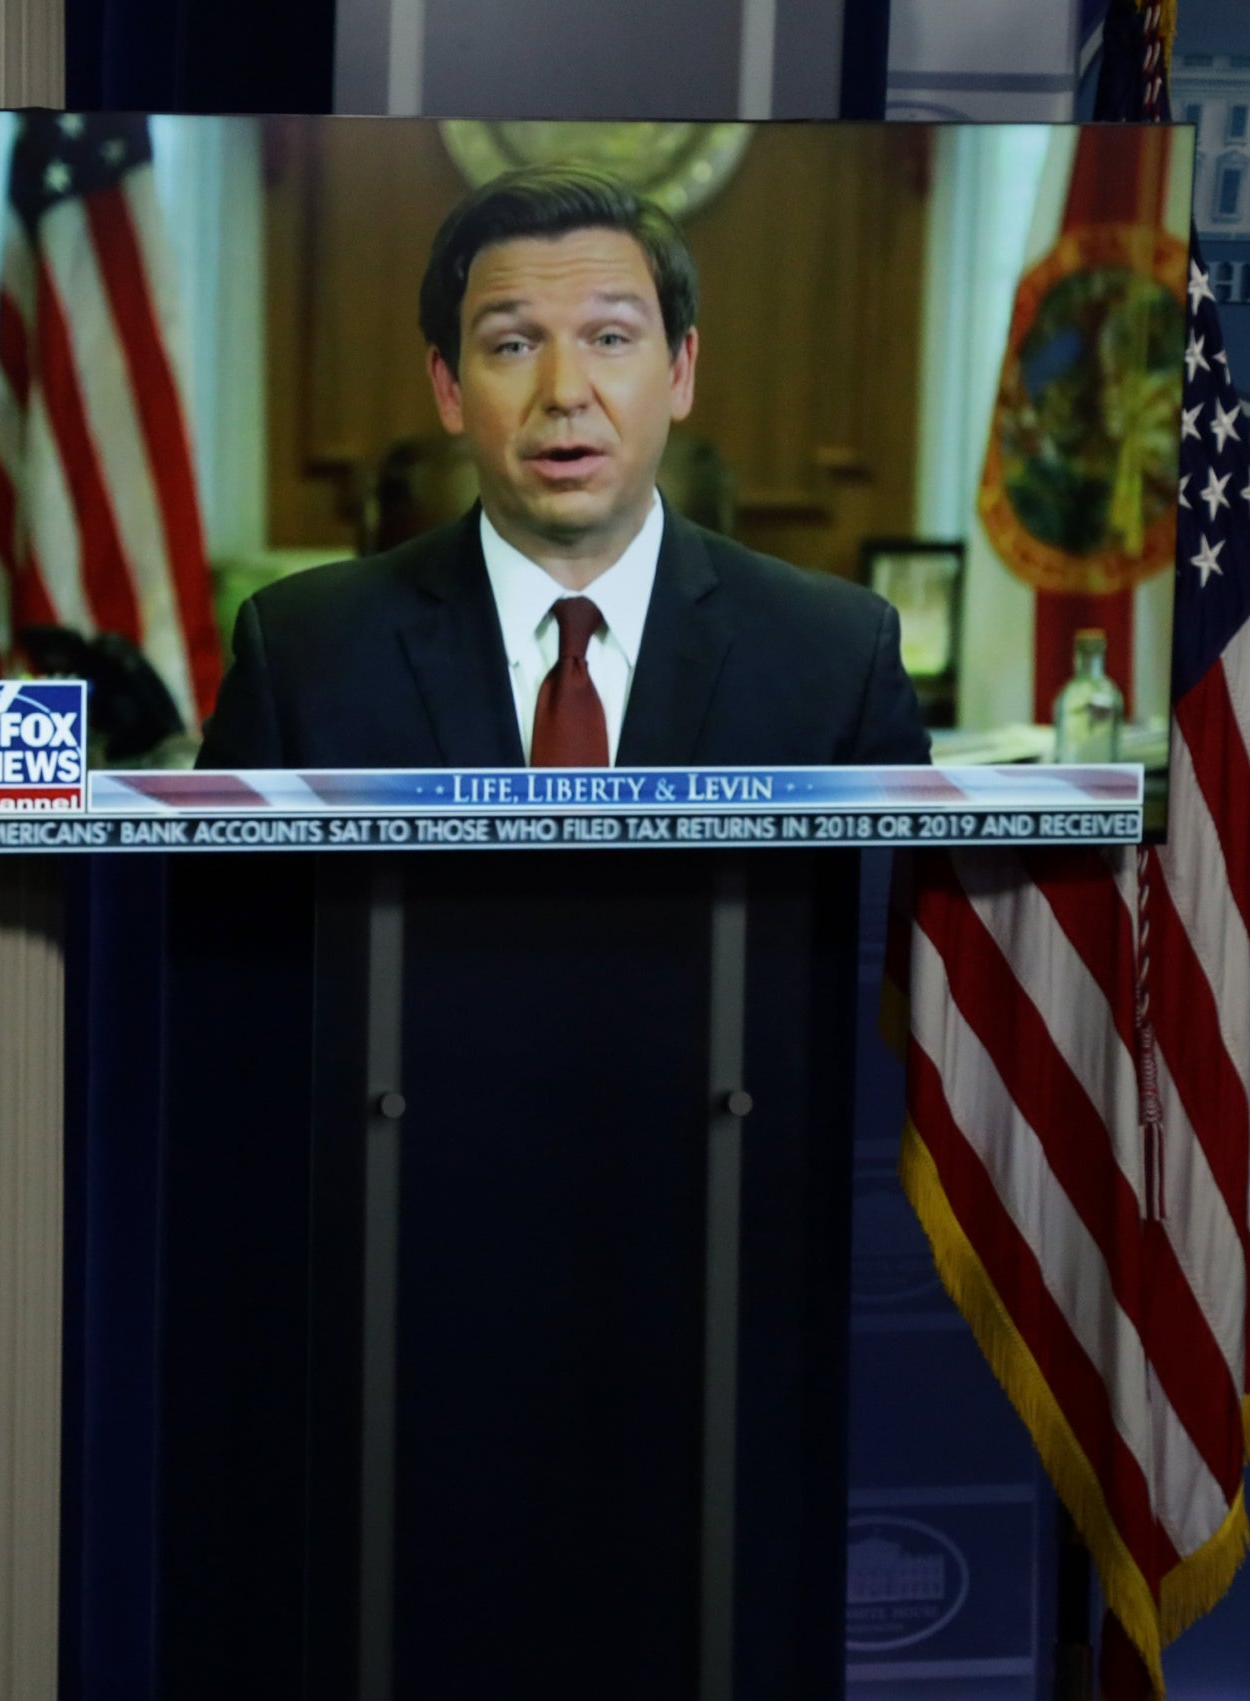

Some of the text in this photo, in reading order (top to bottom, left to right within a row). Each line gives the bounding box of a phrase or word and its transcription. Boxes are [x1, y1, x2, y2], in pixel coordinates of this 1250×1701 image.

[0, 712, 78, 748] FOX
[453, 773, 774, 804] LIFE, LIBERTY & LEVIN
[120, 821, 186, 844] BANK
[192, 820, 322, 844] ACCOUNTS
[328, 819, 376, 843] SAT
[377, 819, 411, 843] TO
[414, 819, 491, 843] THOSE
[494, 818, 558, 842] WHO
[562, 817, 622, 841] FILED
[626, 817, 670, 841] TAX
[676, 816, 776, 840] RETURNS
[782, 816, 810, 839] IN
[814, 815, 873, 840] 2018
[877, 815, 913, 839] OR
[918, 814, 978, 839] 2019
[980, 814, 1034, 838] AND
[1039, 813, 1140, 837] RECEIVED
